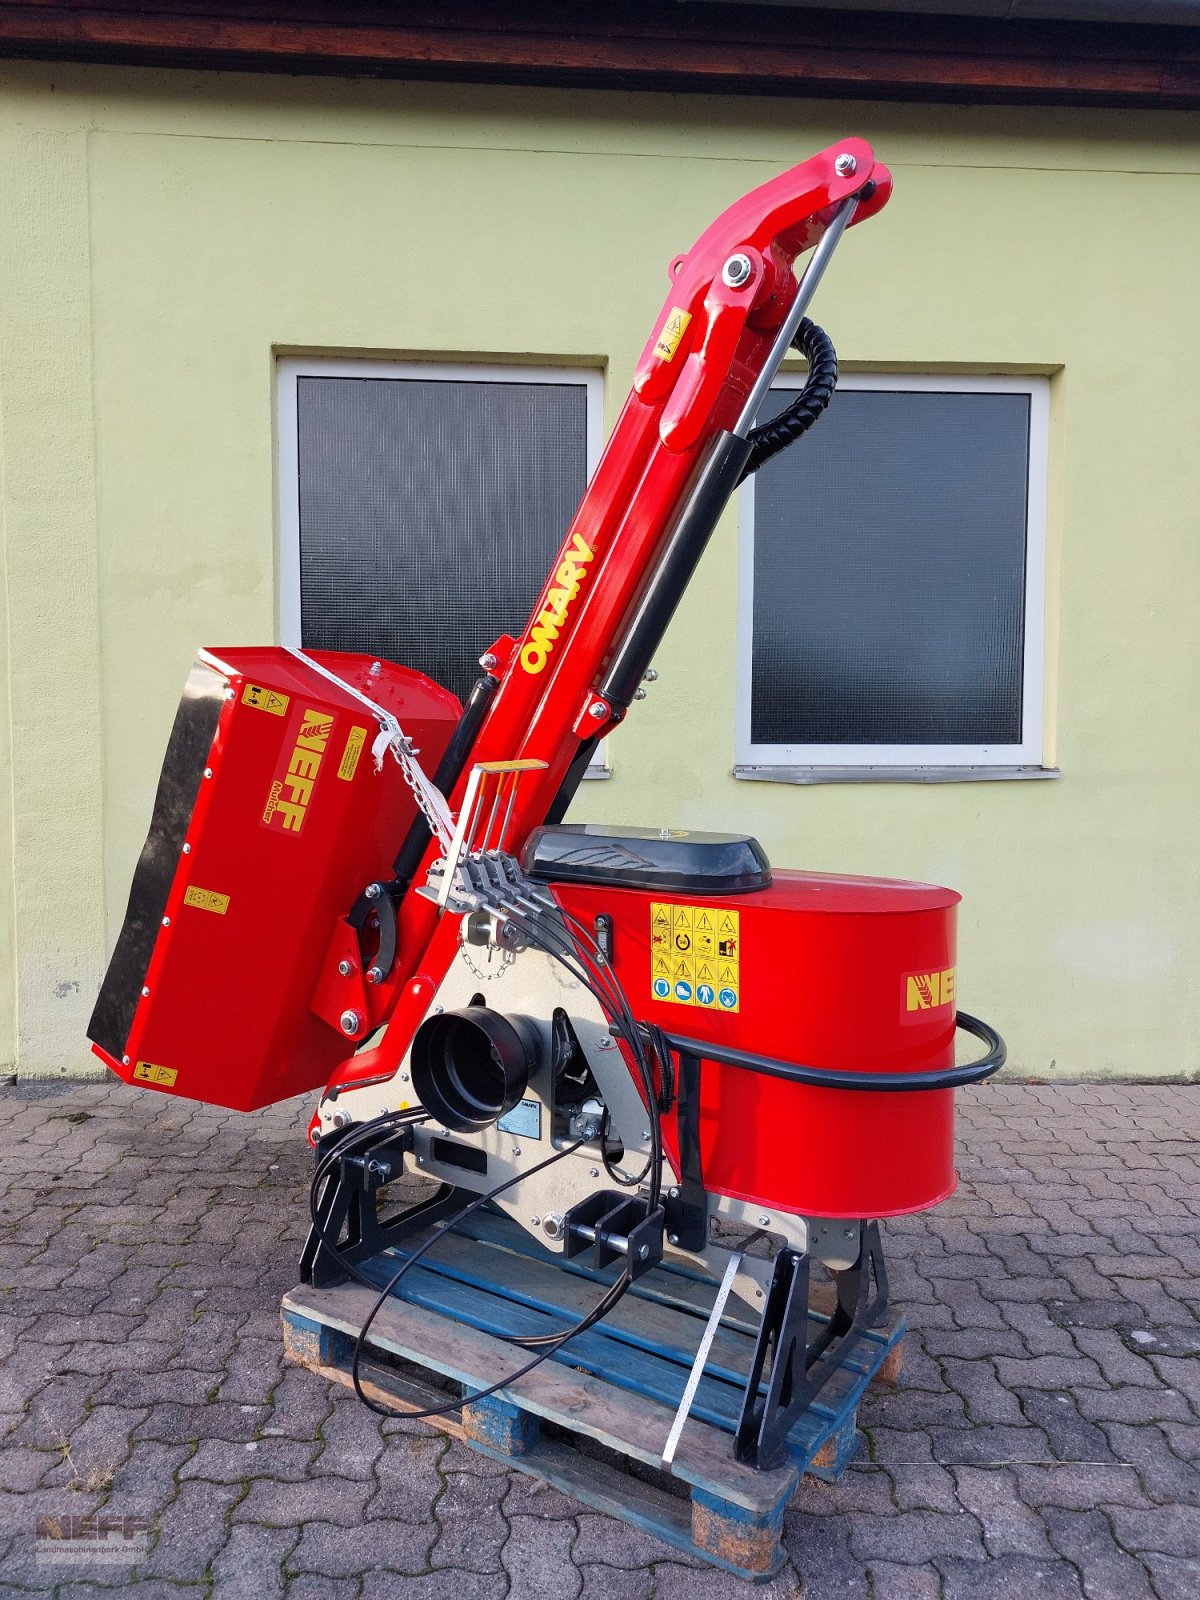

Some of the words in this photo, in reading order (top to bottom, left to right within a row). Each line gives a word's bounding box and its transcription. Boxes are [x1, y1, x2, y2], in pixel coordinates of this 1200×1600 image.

[520, 532, 594, 674] OMARV
[263, 780, 283, 824] Mulcher
[276, 709, 334, 832] NEFF
[907, 968, 955, 1011] NE
